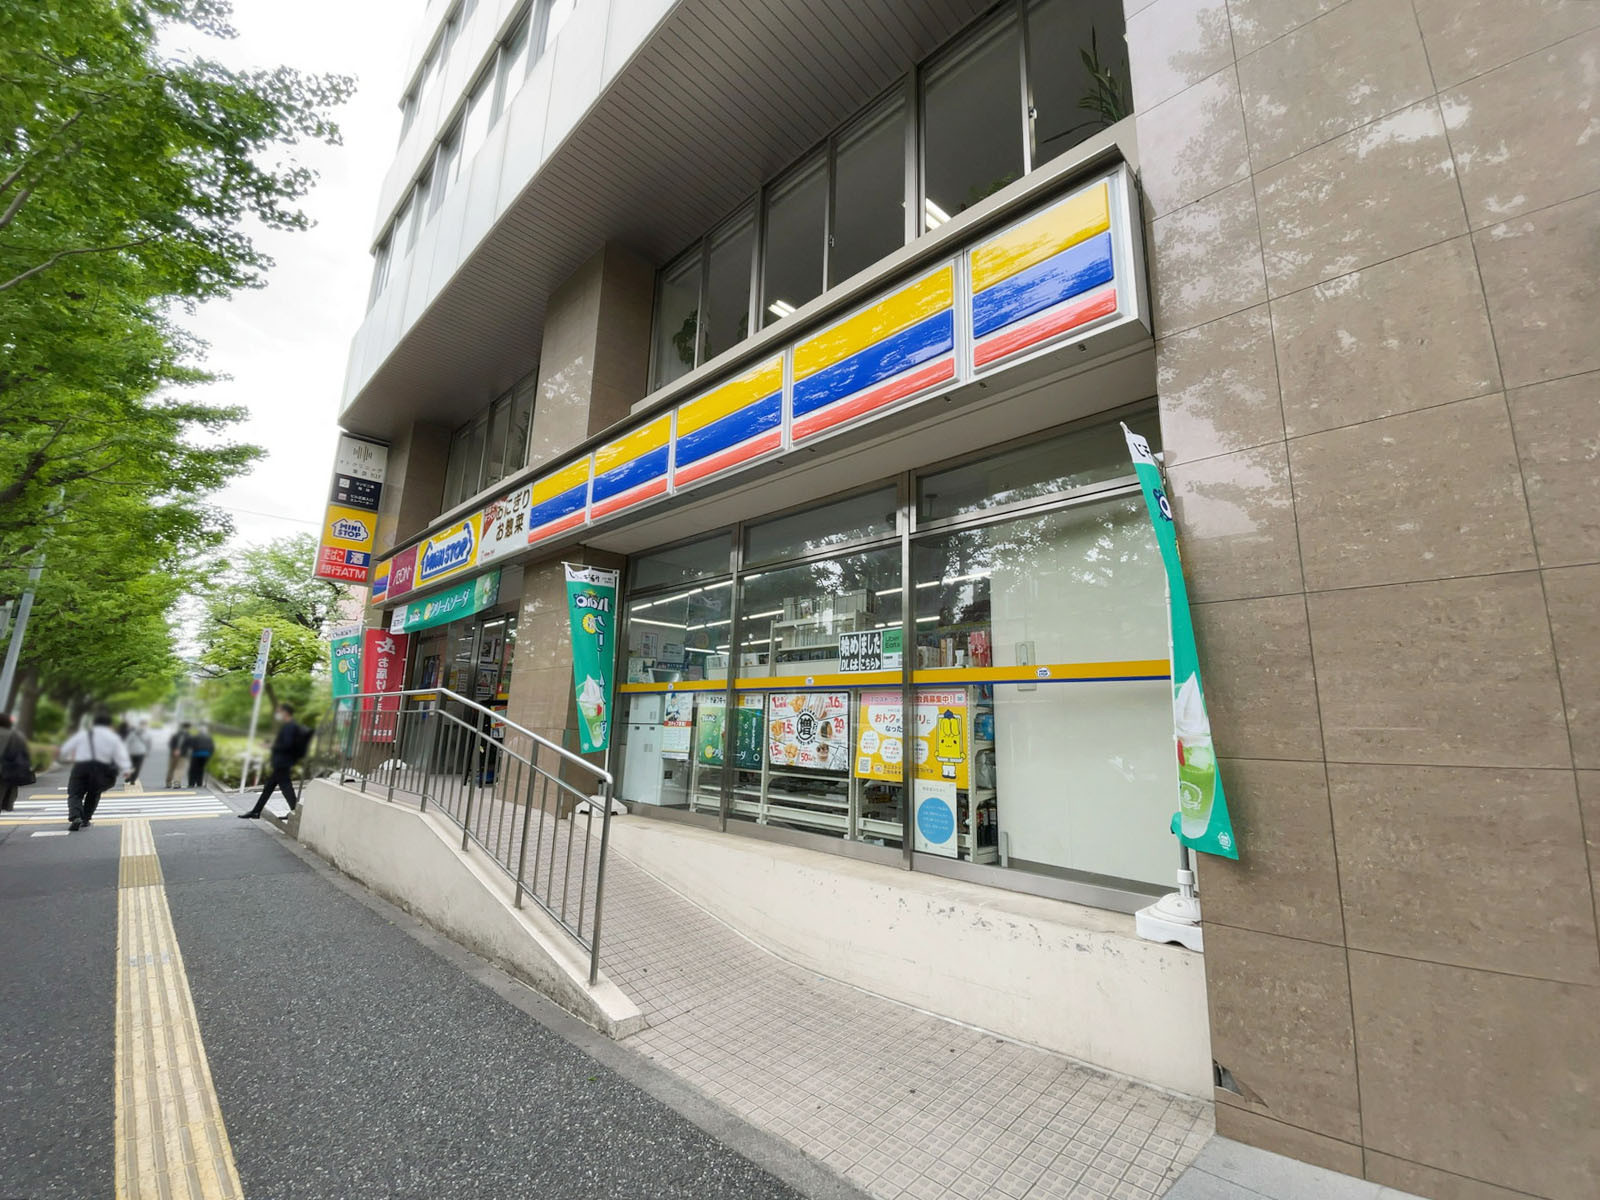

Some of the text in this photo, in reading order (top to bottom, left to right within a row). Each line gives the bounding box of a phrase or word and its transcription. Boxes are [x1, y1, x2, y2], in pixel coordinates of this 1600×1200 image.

[495, 489, 530, 521] おにぎり
[338, 530, 361, 538] STOP
[340, 523, 361, 532] MINI
[324, 548, 365, 565] たばこ 酒
[320, 564, 366, 579] 銀行ATM
[840, 633, 881, 657] 始めました
